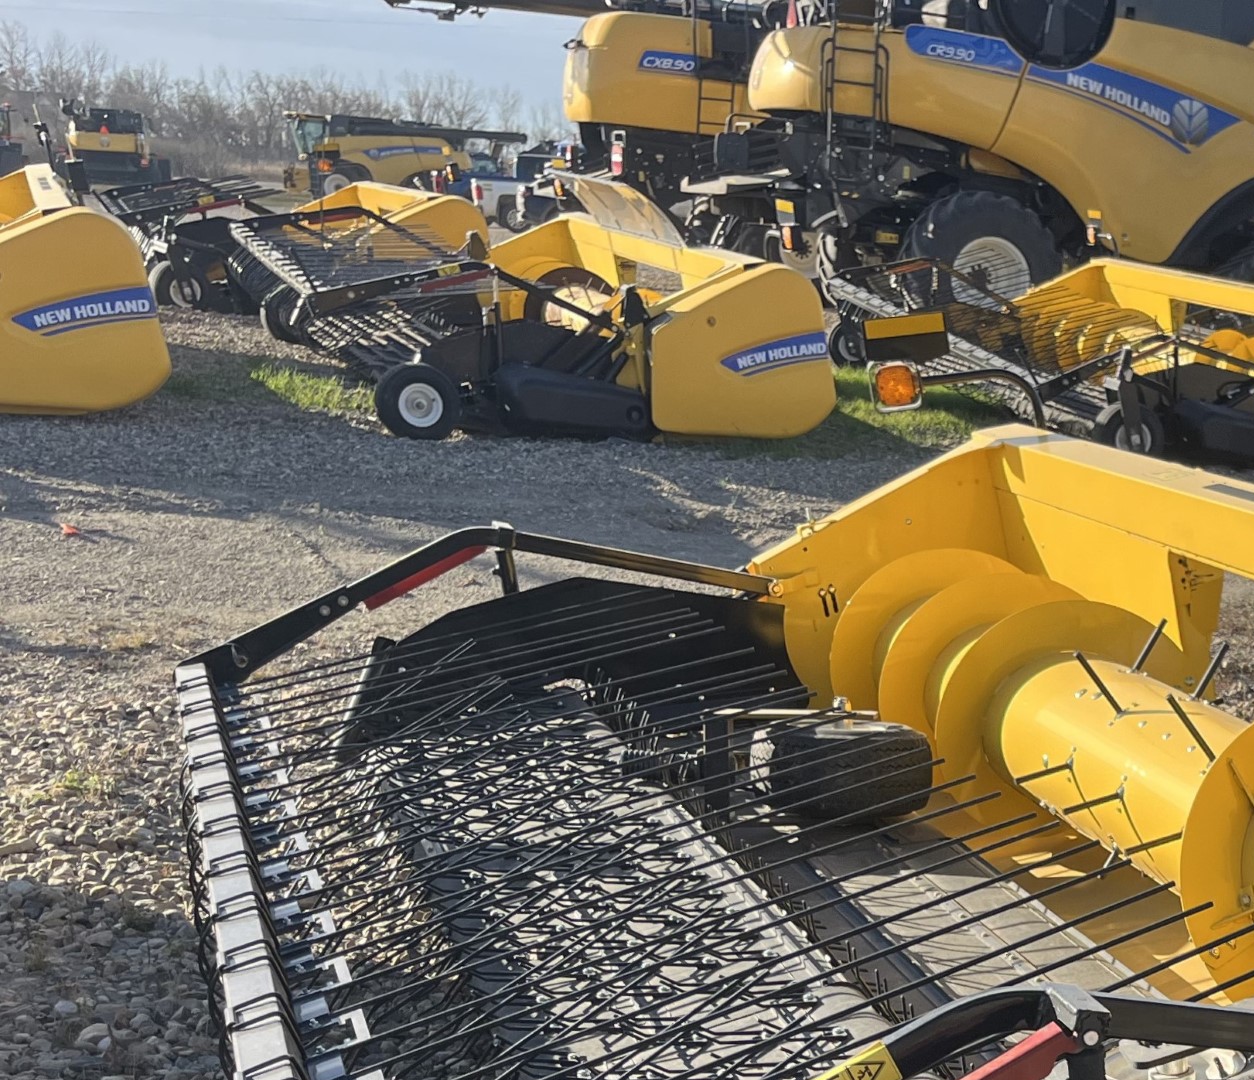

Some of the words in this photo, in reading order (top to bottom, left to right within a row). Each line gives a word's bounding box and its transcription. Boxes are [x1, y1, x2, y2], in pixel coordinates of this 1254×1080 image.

[1066, 72, 1104, 95] NEW
[1104, 85, 1171, 127] HOLLAND
[33, 308, 71, 328] NEW
[75, 299, 150, 319] HOLLAND
[736, 351, 767, 369] NEW
[768, 342, 827, 360] HOLLAND
